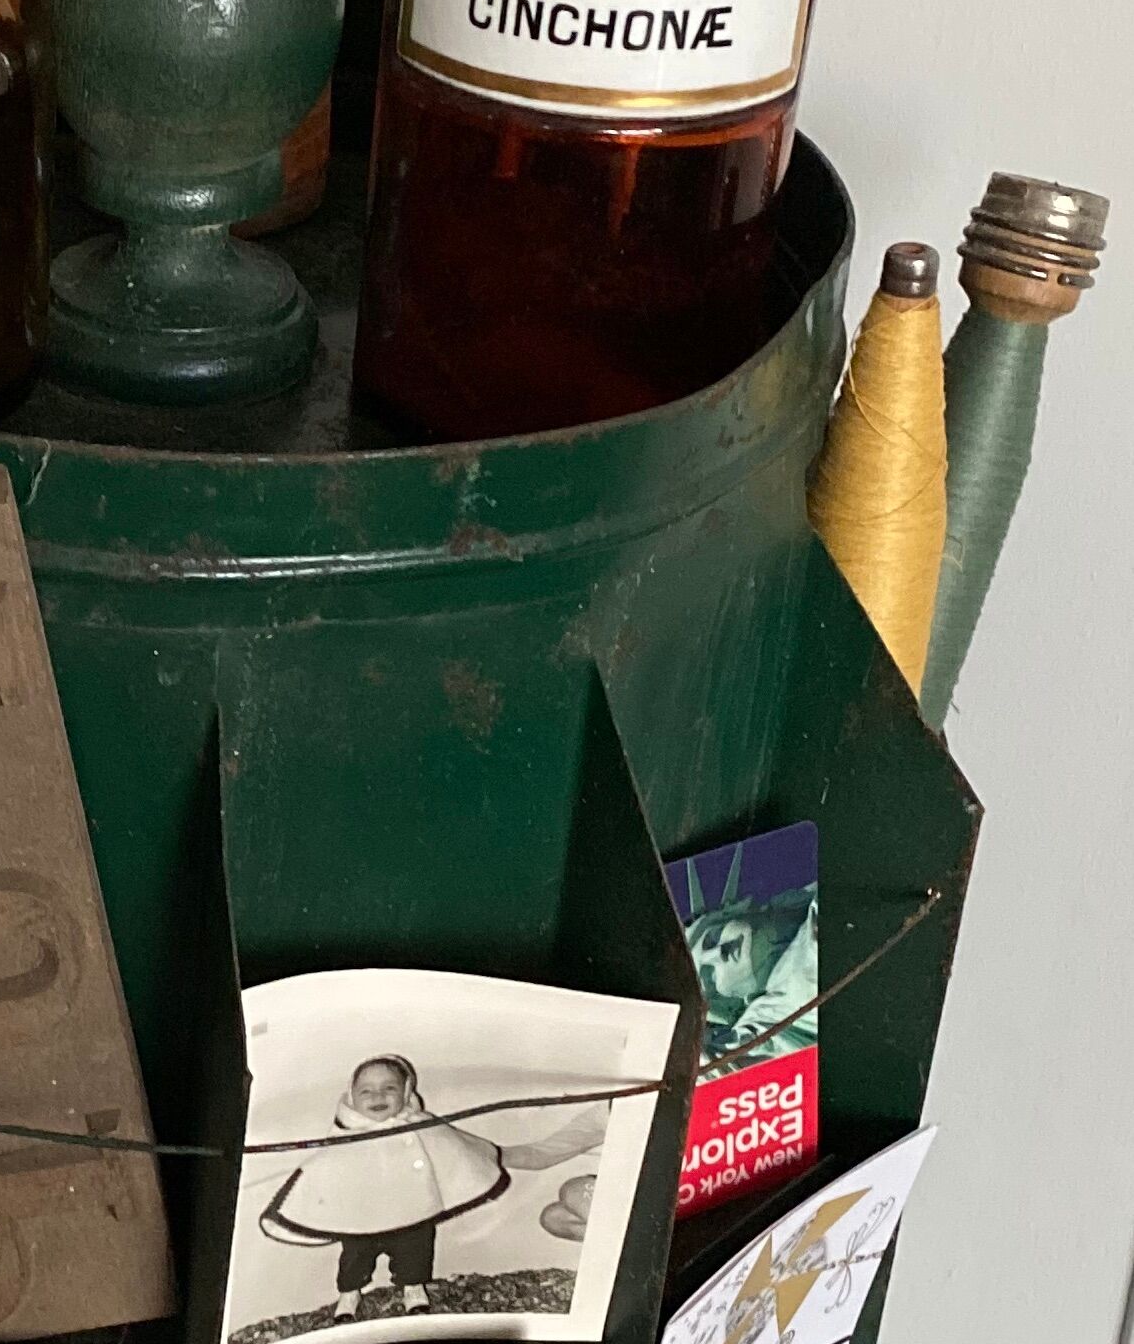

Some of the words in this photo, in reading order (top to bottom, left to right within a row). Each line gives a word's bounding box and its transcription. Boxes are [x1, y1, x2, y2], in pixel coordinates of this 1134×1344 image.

[718, 1073, 803, 1125] Pass
[681, 1108, 803, 1173] Explor
[753, 1142, 803, 1174] New
[699, 1161, 751, 1196] York
